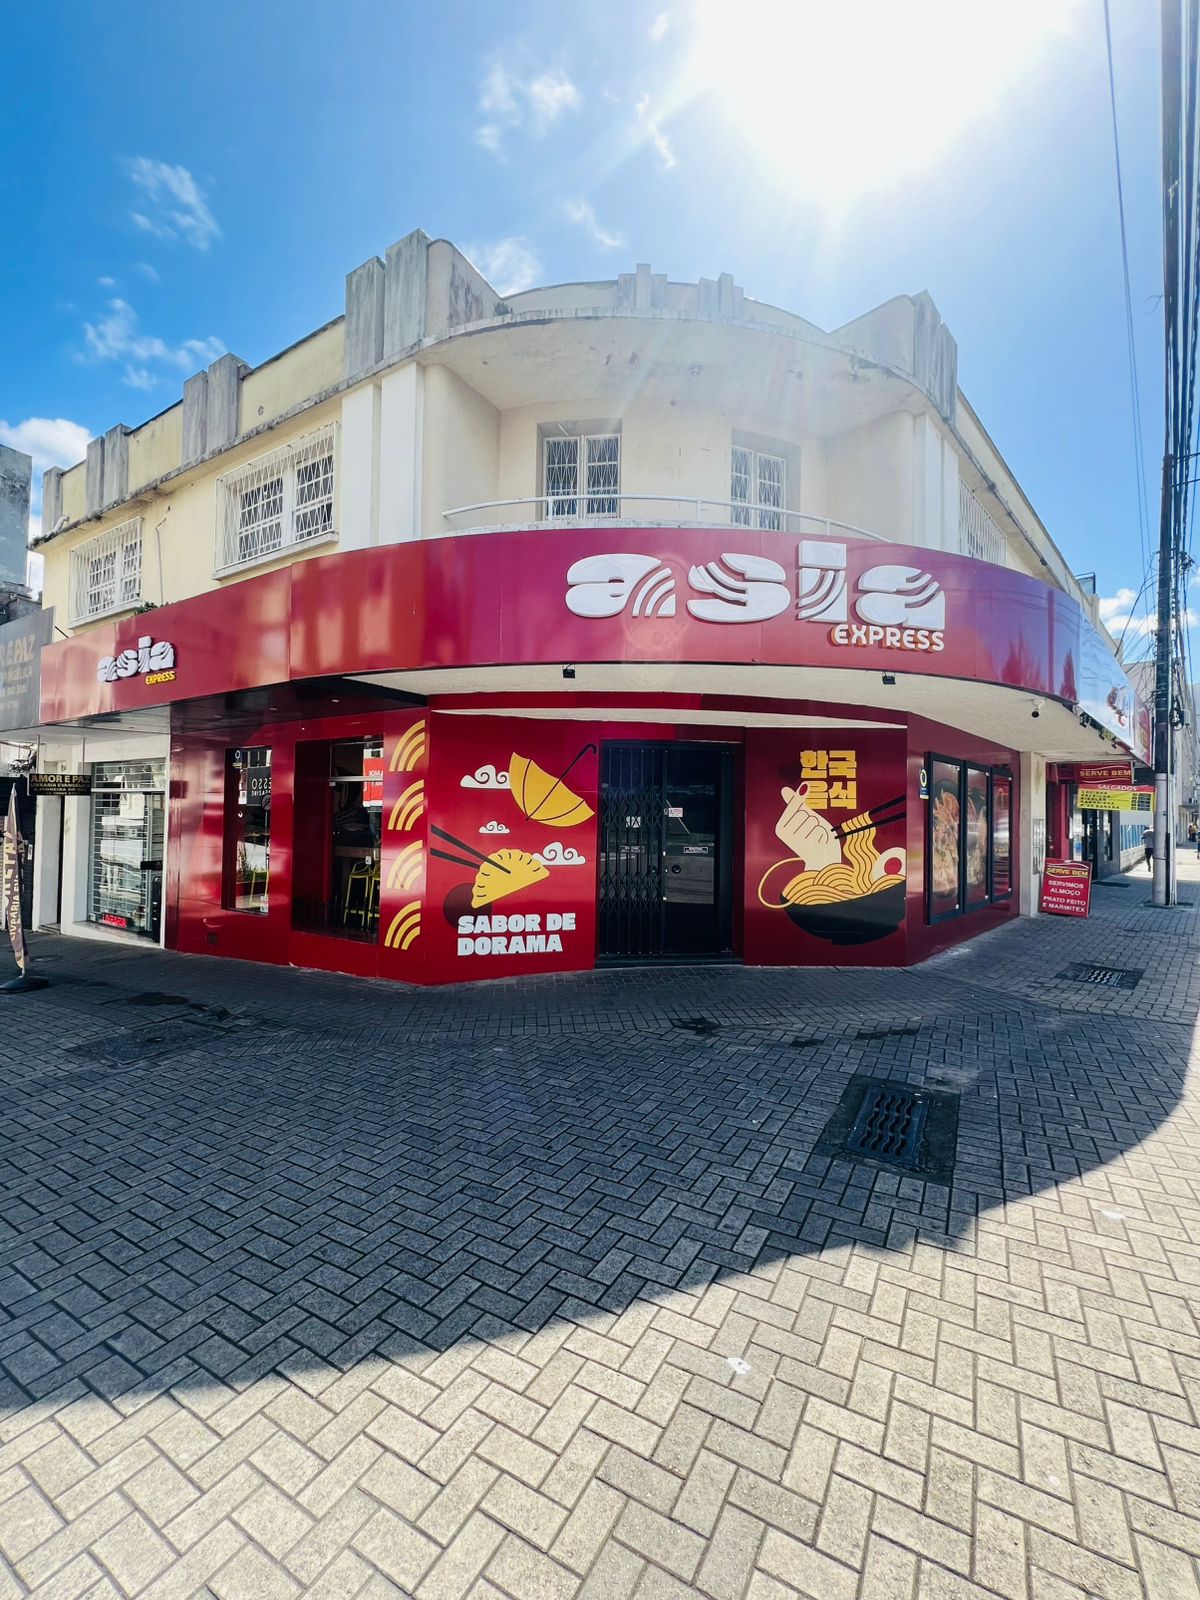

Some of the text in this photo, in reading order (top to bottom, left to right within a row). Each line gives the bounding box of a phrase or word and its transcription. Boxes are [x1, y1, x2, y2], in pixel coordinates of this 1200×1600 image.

[833, 624, 945, 651] EXPRESS
[145, 670, 176, 685] EXPRESS
[800, 750, 857, 779] 한국
[1080, 769, 1109, 777] SERVE
[30, 774, 90, 784] AMOR E PAZ
[805, 780, 857, 810] 음식
[1047, 867, 1070, 875] SERVE
[1047, 880, 1084, 889] SERVIMOS
[1050, 887, 1081, 896] ALMOÇO
[1066, 898, 1086, 906] FEITO
[1048, 903, 1086, 913] MARMITEX
[457, 912, 576, 934] SABOR DE
[457, 934, 563, 956] DORAMA
